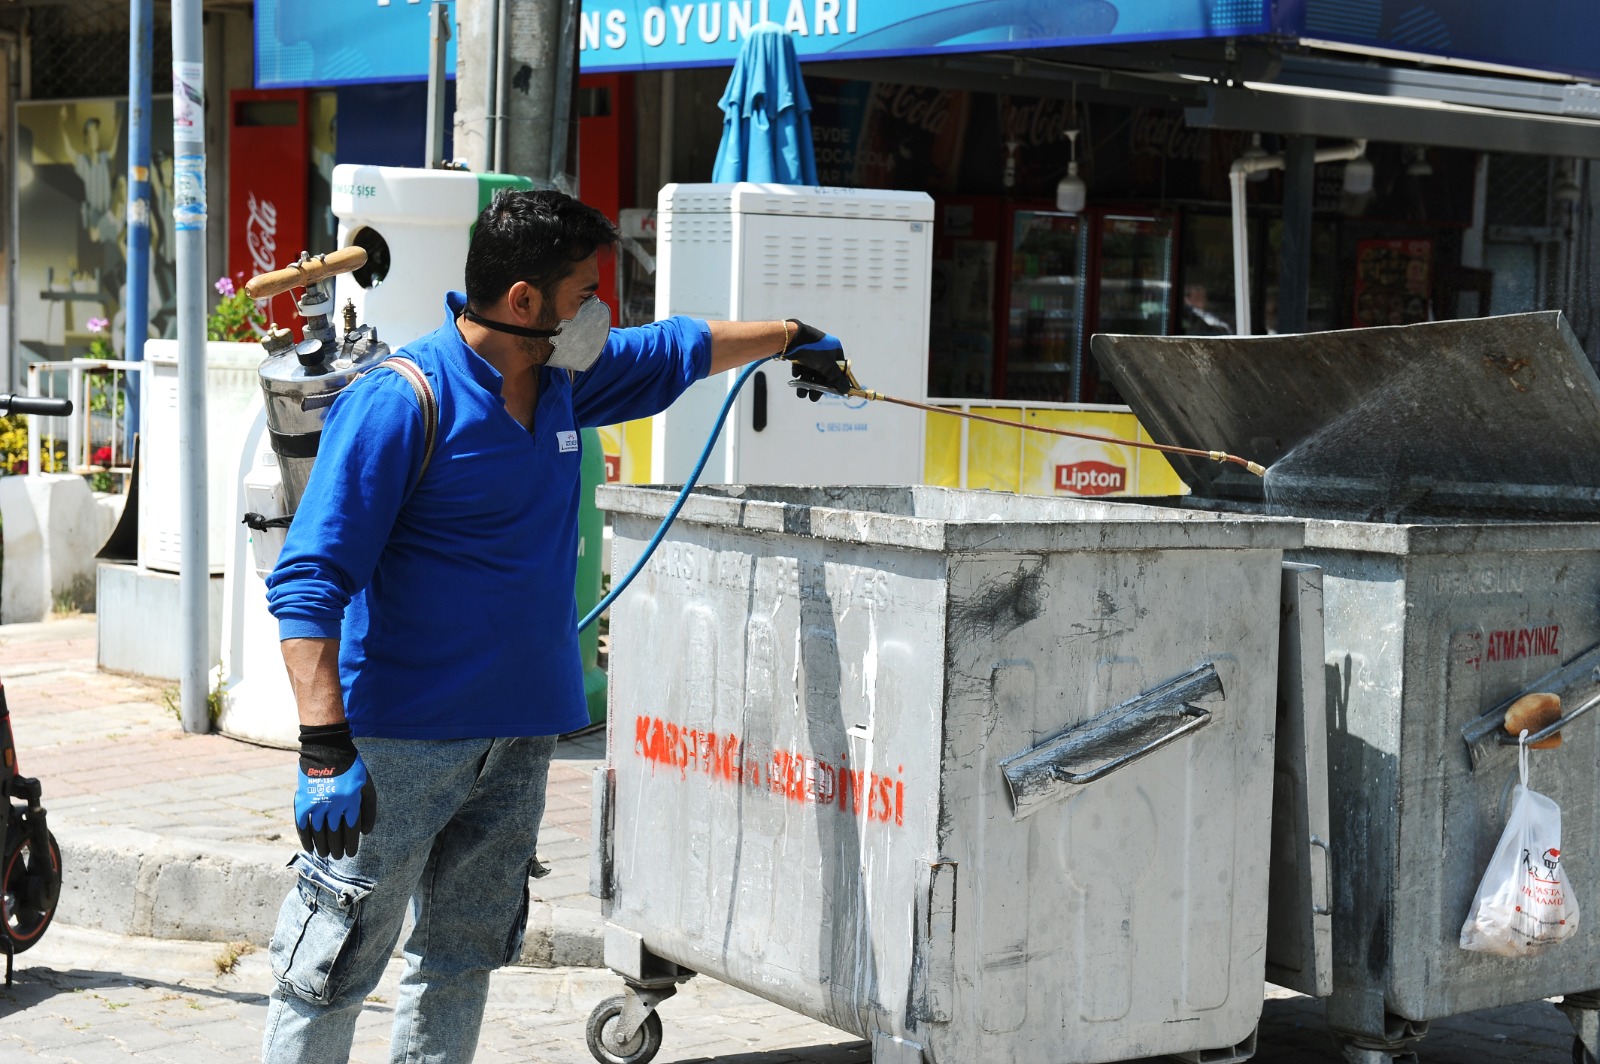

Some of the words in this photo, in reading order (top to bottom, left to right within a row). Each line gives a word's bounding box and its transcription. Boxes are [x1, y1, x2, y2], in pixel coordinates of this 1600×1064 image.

[579, 9, 627, 50] NS
[1061, 467, 1121, 490] Lipton
[1486, 625, 1559, 663] ATMAYINIZ
[307, 767, 334, 776] Beybi
